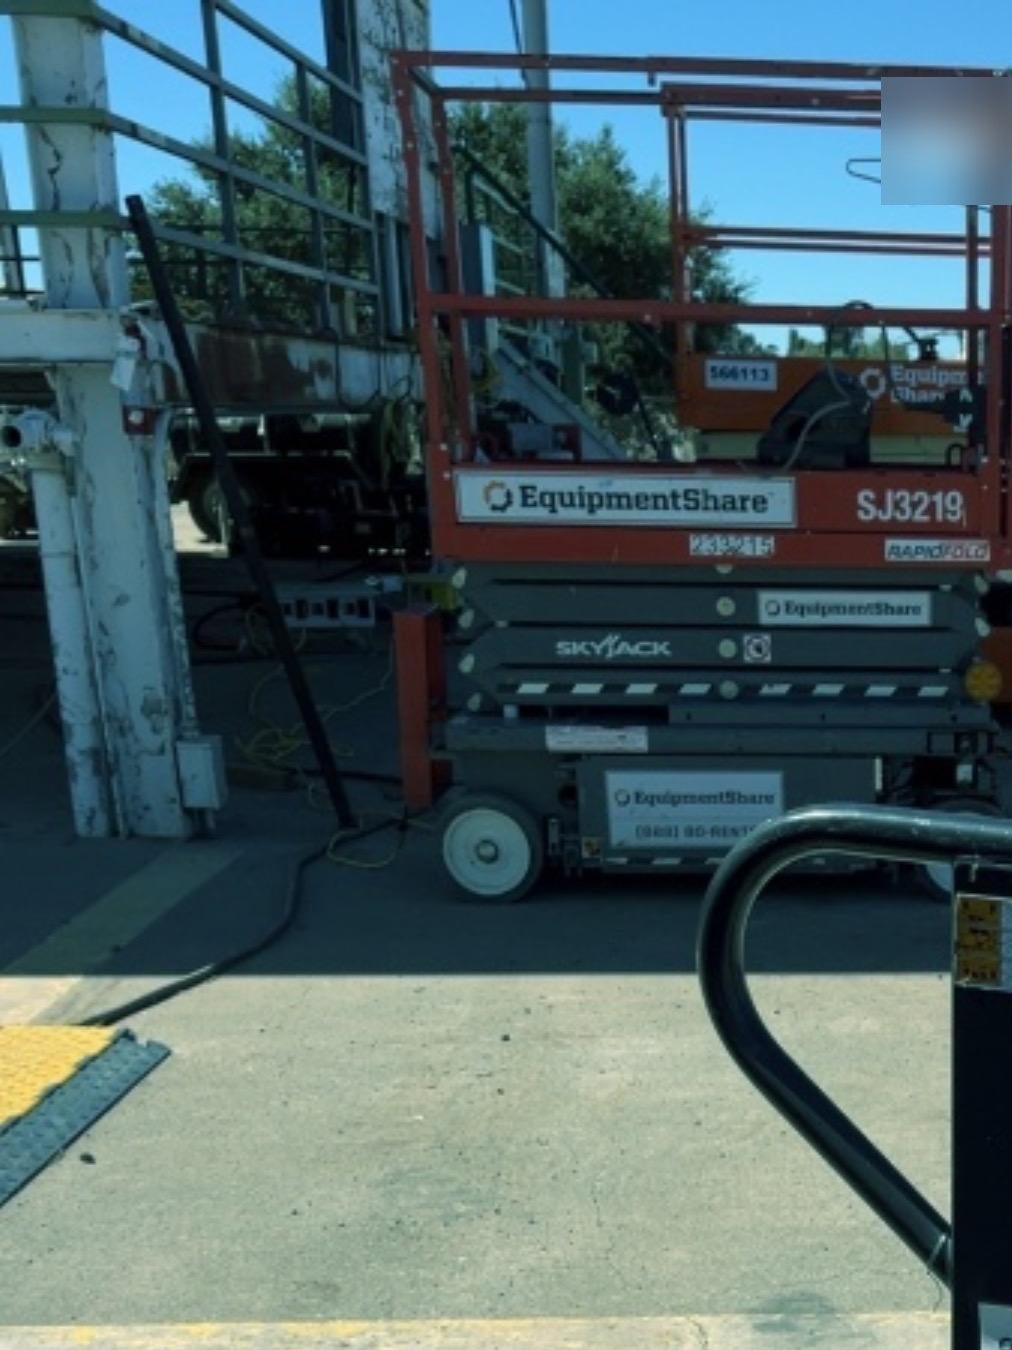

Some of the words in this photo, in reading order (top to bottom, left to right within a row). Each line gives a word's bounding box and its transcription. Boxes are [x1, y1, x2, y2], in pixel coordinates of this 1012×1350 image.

[519, 485, 768, 515] EquipmentShare
[857, 489, 963, 524] SJ3219
[783, 602, 922, 618] EquipmentShare
[557, 631, 672, 659] SKYJACK
[633, 790, 775, 807] EquipmentShare
